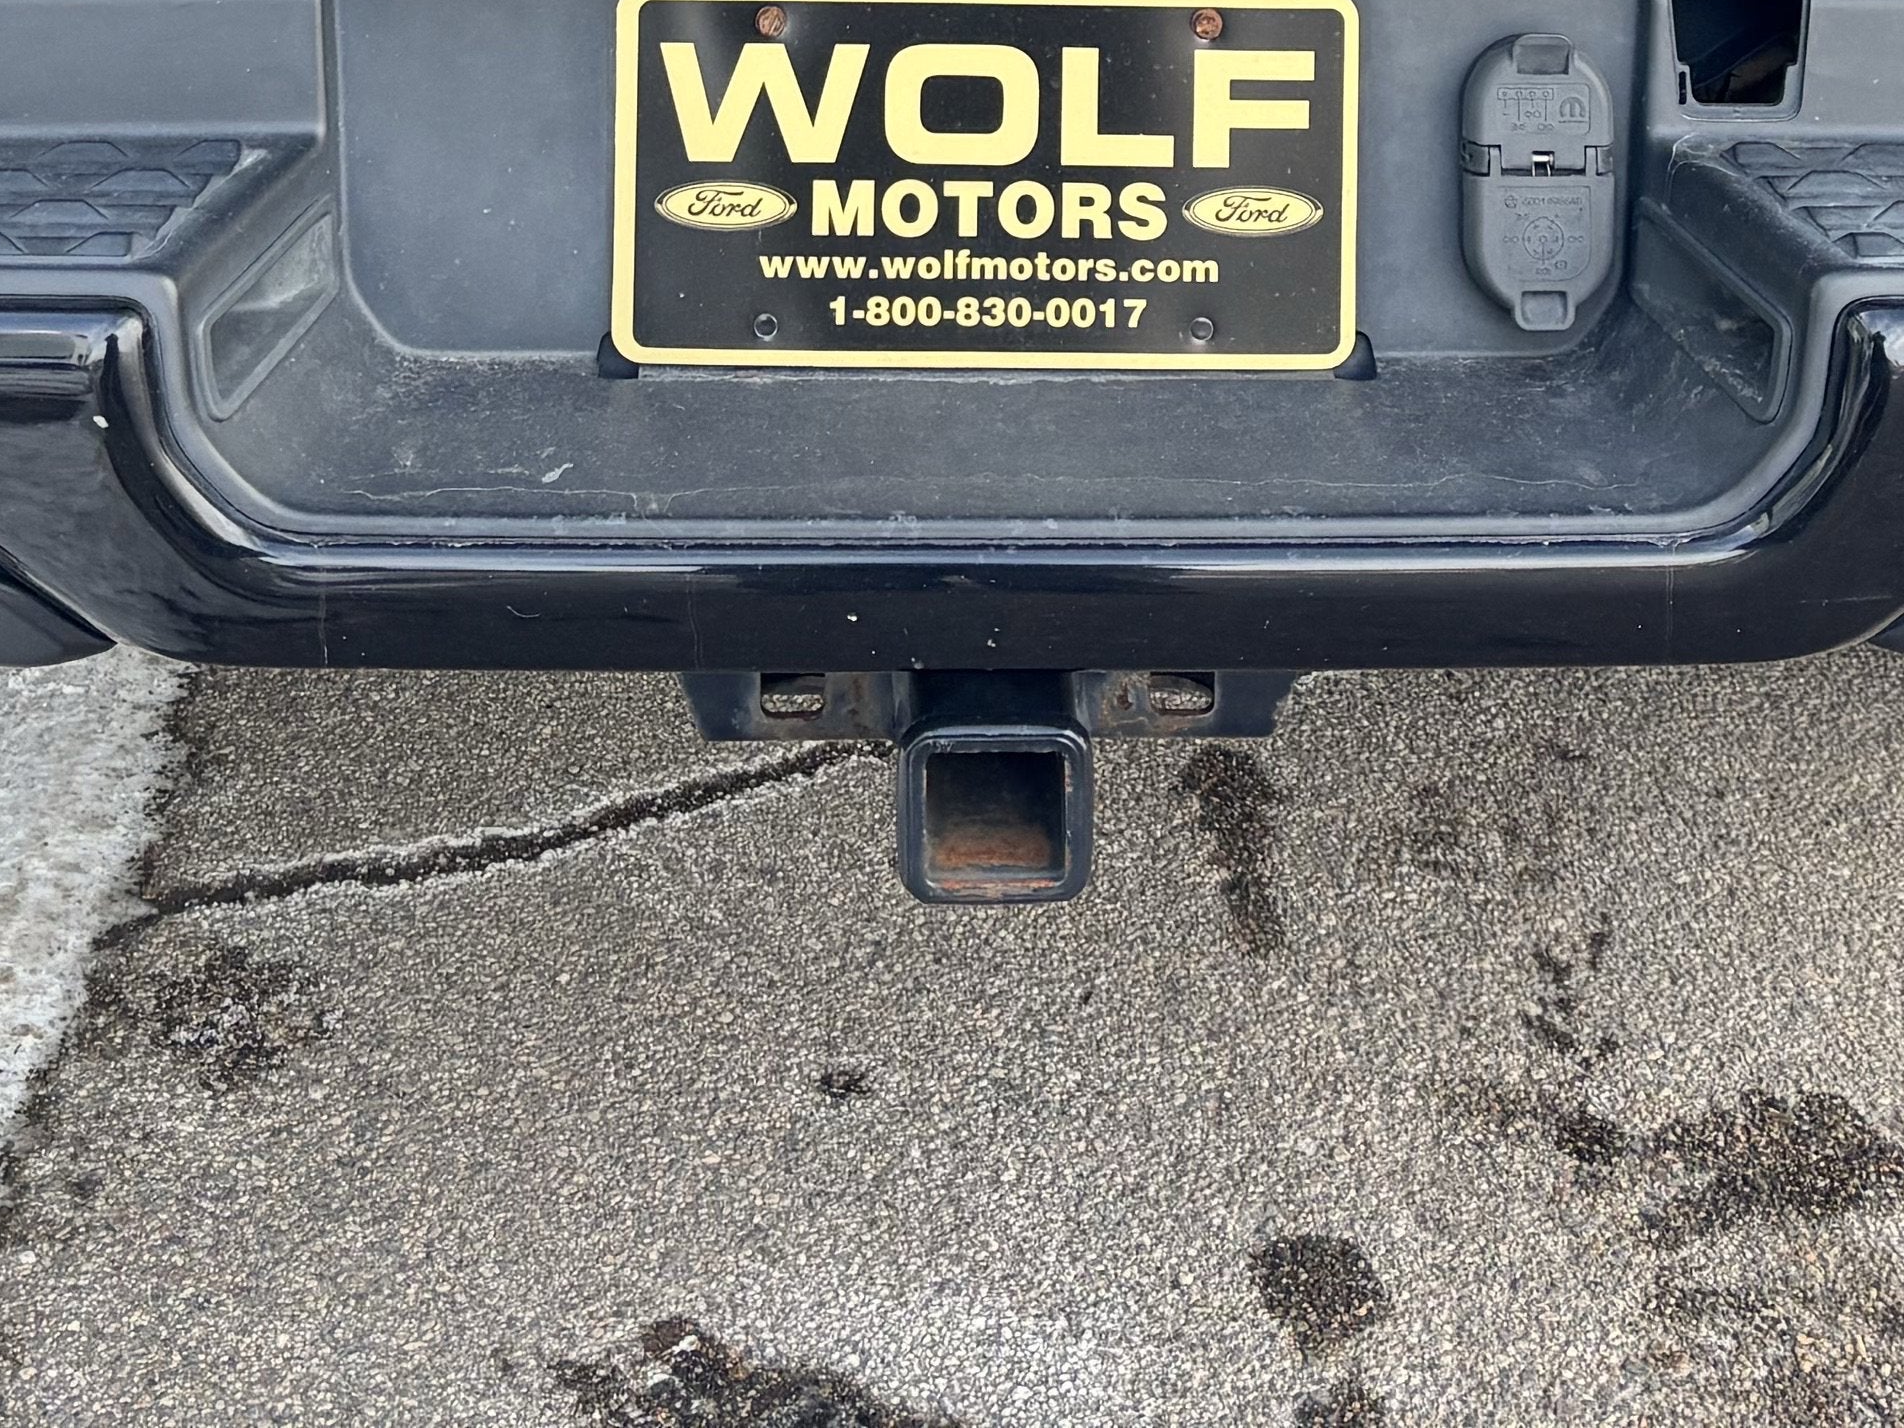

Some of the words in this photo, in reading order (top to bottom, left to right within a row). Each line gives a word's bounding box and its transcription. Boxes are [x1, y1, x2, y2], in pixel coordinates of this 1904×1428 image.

[660, 42, 1316, 170] WOLF
[687, 189, 764, 218] Ford
[811, 179, 1169, 242] MOTORS
[1214, 195, 1291, 223] Ford
[759, 248, 1220, 284] www.wolfmotors.com
[828, 296, 1149, 329] 1-800-830-0017
